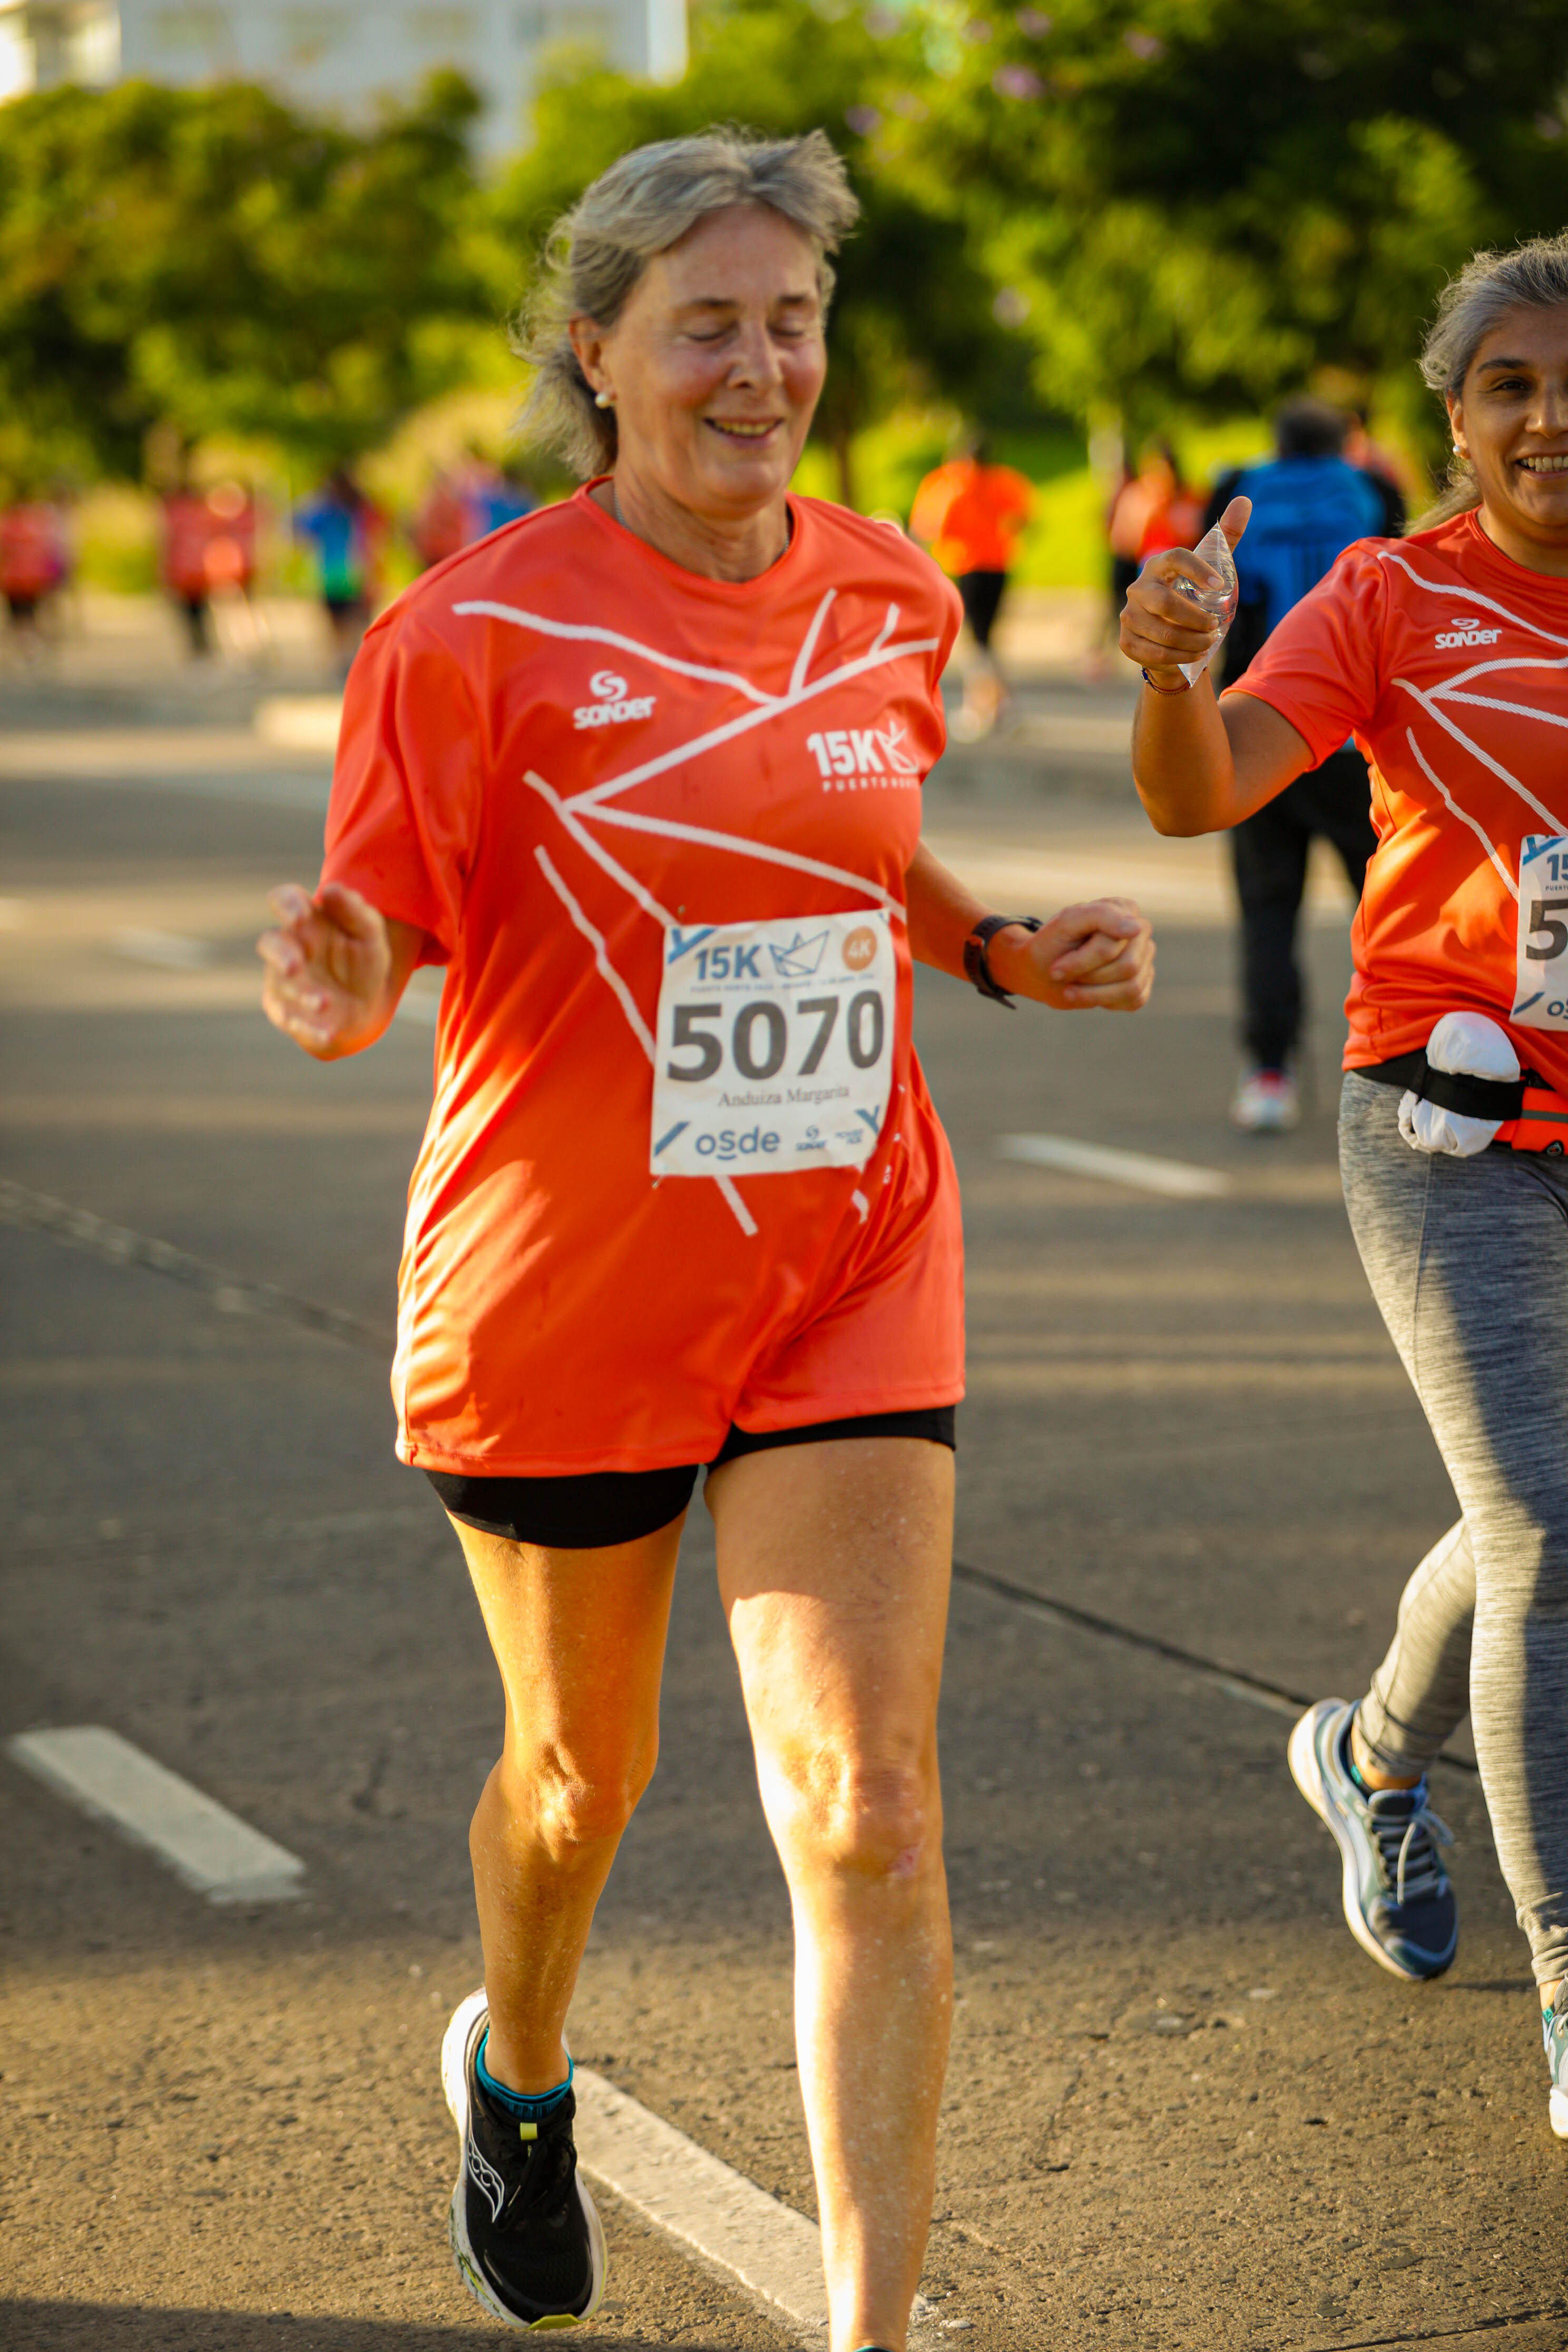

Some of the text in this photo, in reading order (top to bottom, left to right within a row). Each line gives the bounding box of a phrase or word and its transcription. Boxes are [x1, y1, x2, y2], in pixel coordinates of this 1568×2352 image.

[807, 729, 885, 777] 15K
[694, 944, 761, 981] 15K
[848, 938, 871, 959] 4K
[667, 988, 884, 1082] 5070
[718, 1085, 850, 1106] Anduiza Margarita
[695, 1124, 780, 1156] osde
